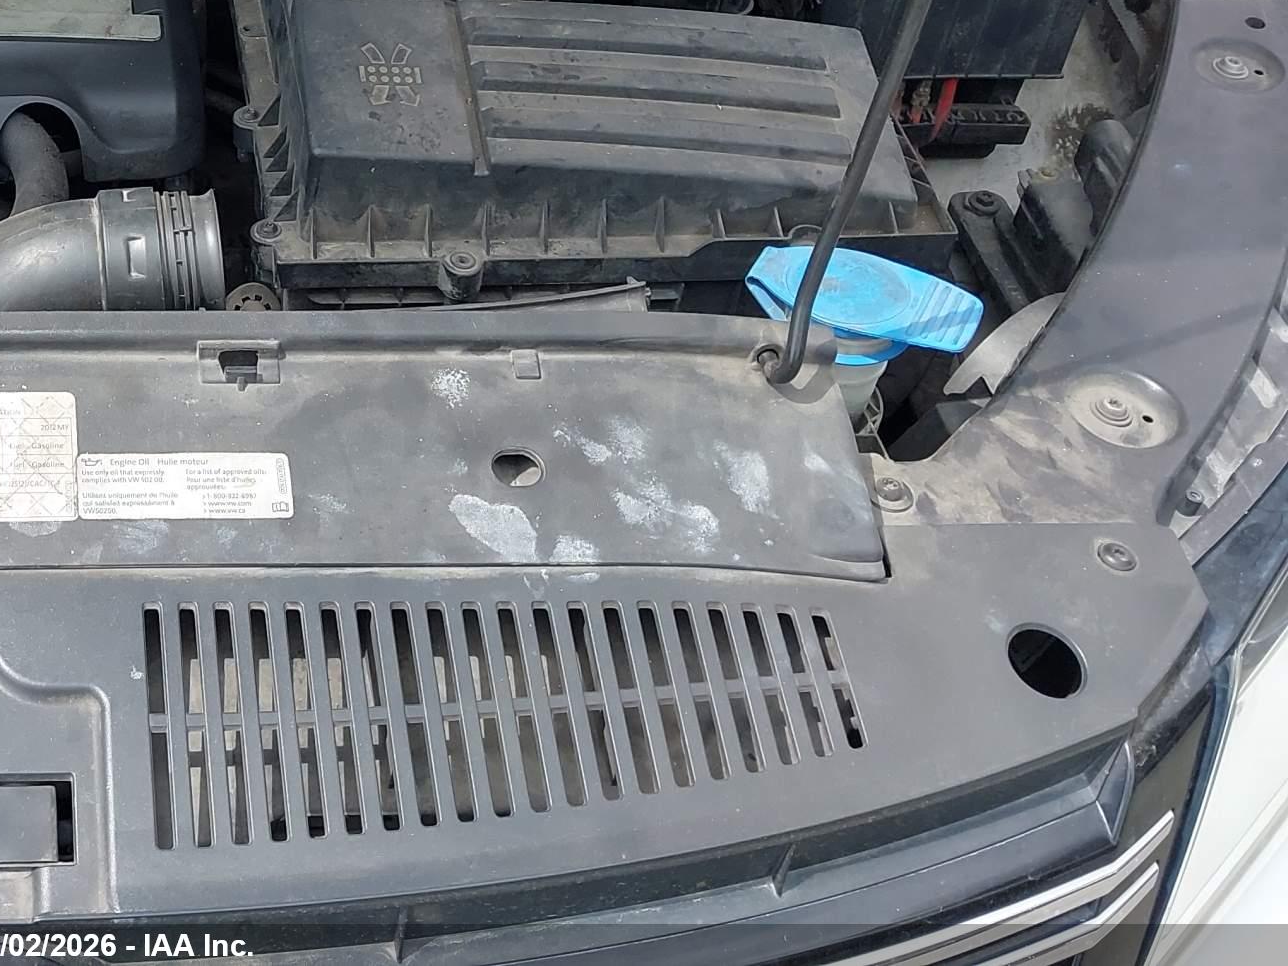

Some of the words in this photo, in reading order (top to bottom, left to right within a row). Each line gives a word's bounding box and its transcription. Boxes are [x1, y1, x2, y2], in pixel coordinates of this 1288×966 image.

[32, 442, 64, 450] Gasoline
[110, 458, 136, 467] Engine
[134, 468, 165, 476] expressly
[223, 468, 252, 476] approved
[82, 476, 110, 484] complies
